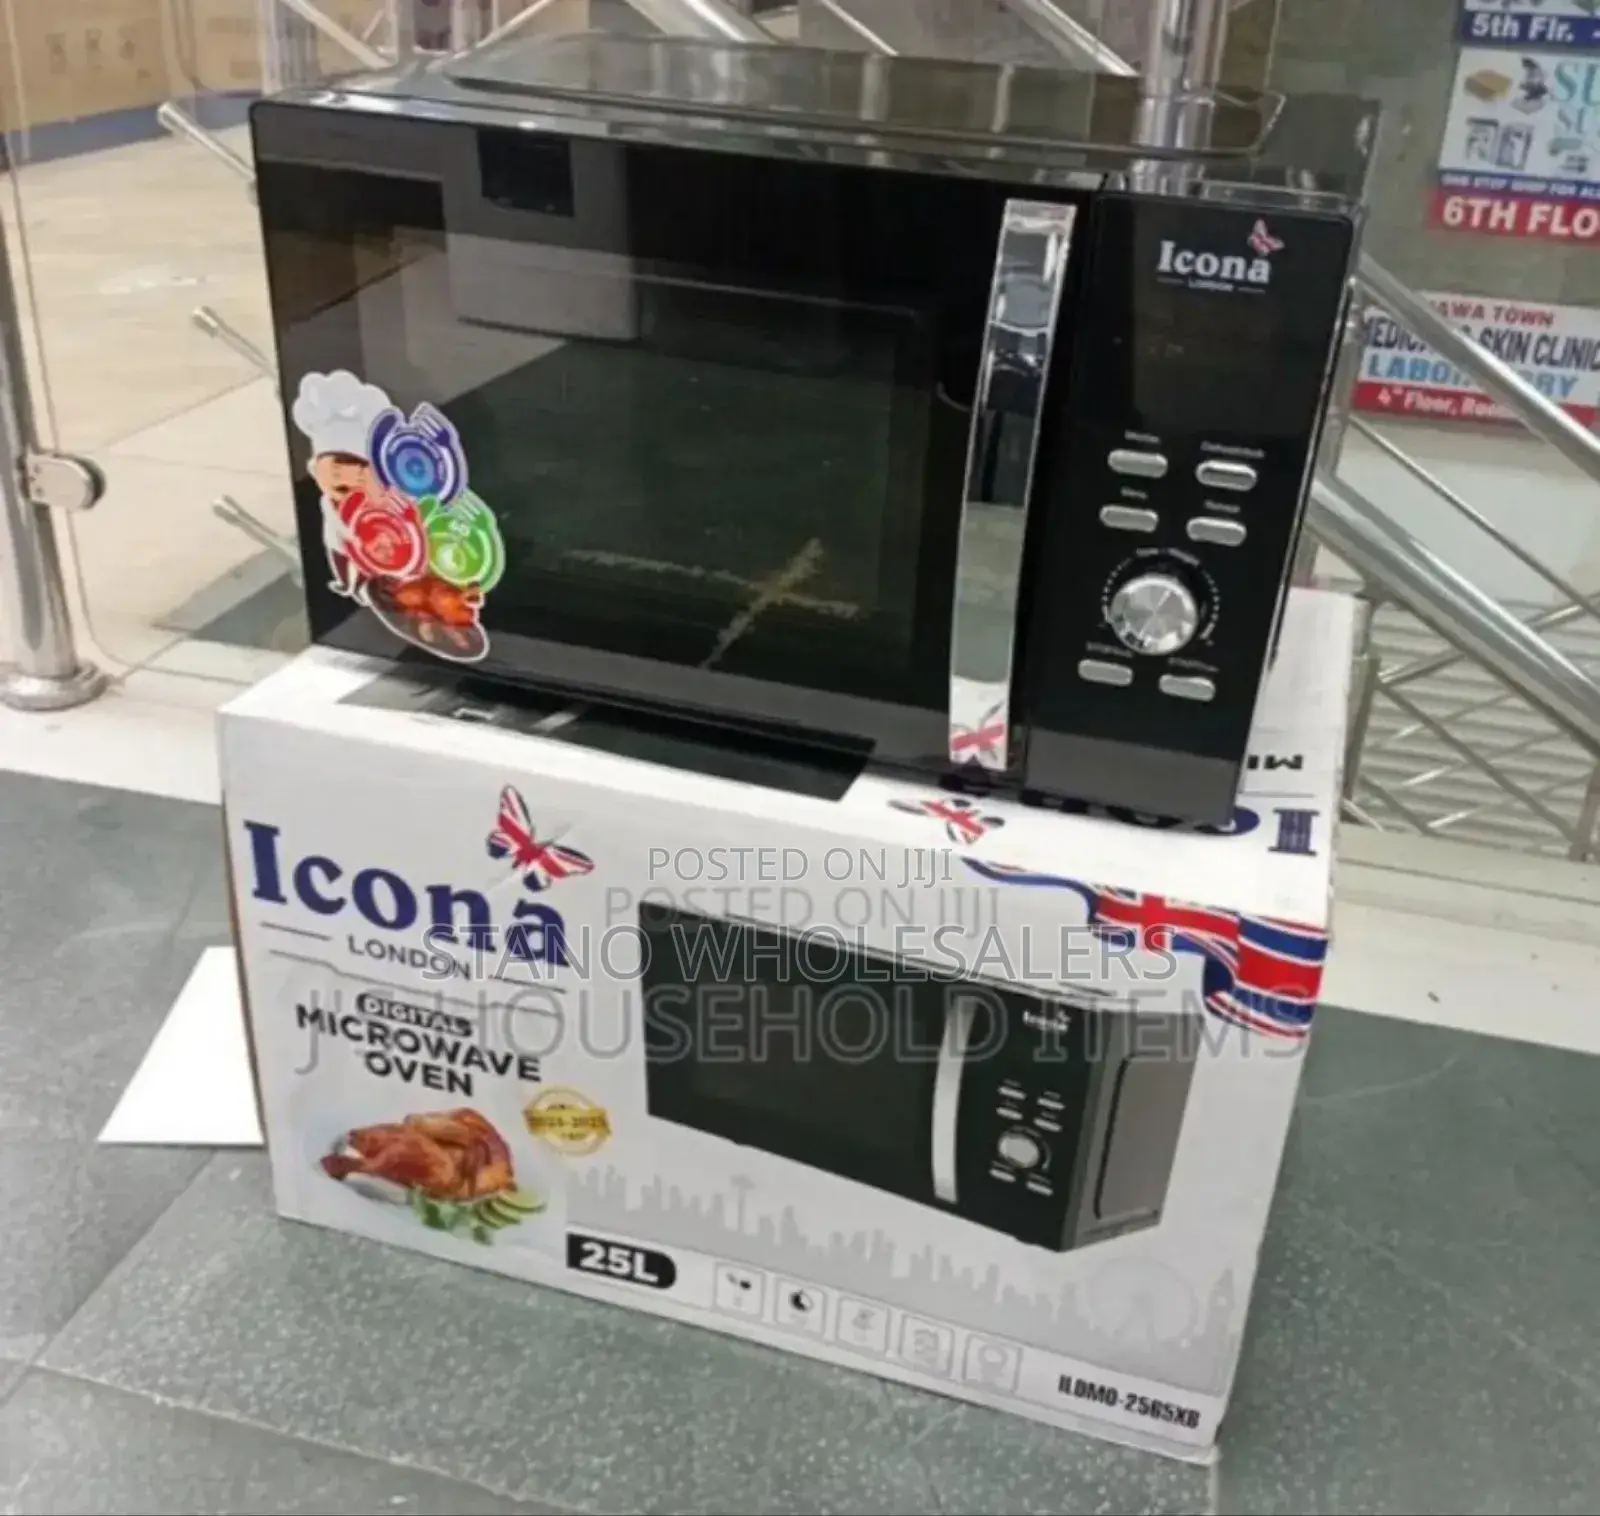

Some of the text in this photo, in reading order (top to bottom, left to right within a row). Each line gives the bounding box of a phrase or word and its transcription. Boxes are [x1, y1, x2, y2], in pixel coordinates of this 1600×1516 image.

[1471, 12, 1575, 42] 5th Flr.
[1442, 195, 1518, 231] 6TH
[1156, 239, 1271, 285] Icona
[1494, 306, 1555, 326] TOWN
[243, 818, 570, 968] Icona
[347, 934, 471, 981] LONDON
[295, 1004, 542, 1083] MICROWAVE
[364, 1050, 473, 1097] OVEN
[580, 1241, 659, 1283] 25L
